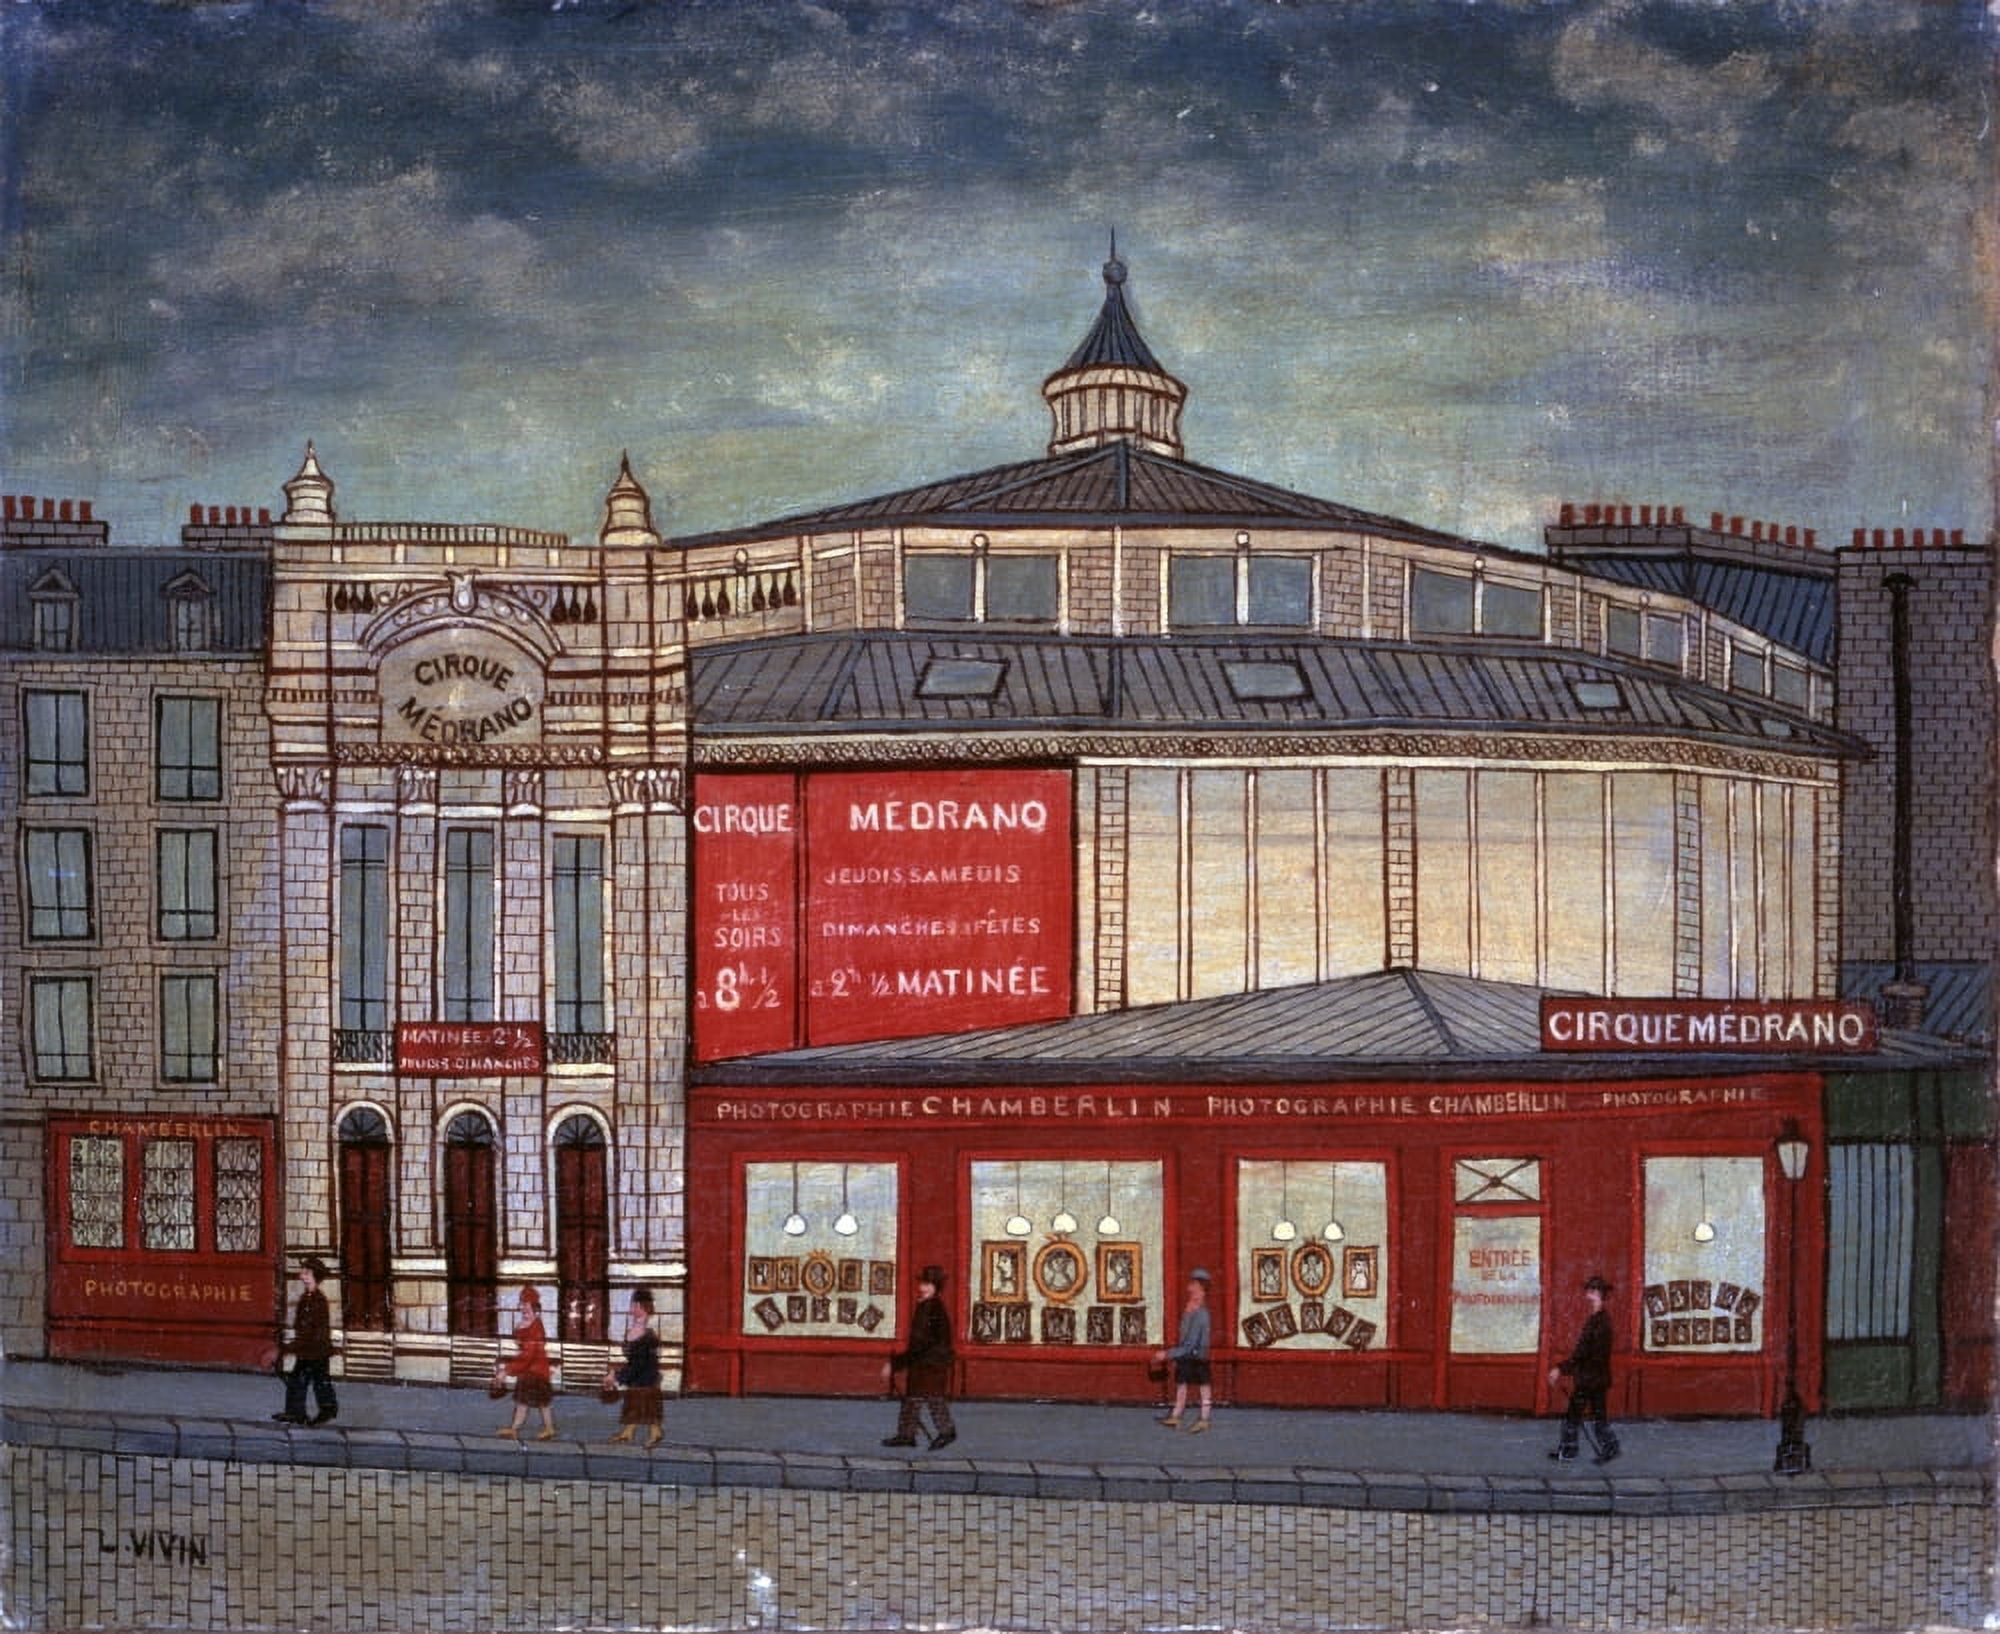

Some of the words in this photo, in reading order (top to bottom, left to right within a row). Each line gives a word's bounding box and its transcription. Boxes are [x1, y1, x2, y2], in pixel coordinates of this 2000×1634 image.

[414, 653, 514, 692] CIRQUE
[693, 803, 793, 836] CIRQUE
[849, 791, 1048, 834] MÉDRANO
[715, 883, 769, 902] TOUS
[714, 927, 781, 949] SOIRS
[898, 956, 1051, 997] MATINÉE
[1549, 1010, 1681, 1045] CIRQUE
[1689, 1004, 1865, 1046] MÉDRANO
[717, 1101, 912, 1121] PHOTOGRAPHIE
[921, 1094, 1172, 1118] CHAMBERLIN
[1207, 1095, 1418, 1117] PHOTOGRAPHIE
[1428, 1090, 1567, 1115] CHAMBERLIN
[88, 1120, 242, 1137] CHAMBERLIN
[84, 1279, 254, 1301] PHOTOGRAPHIE
